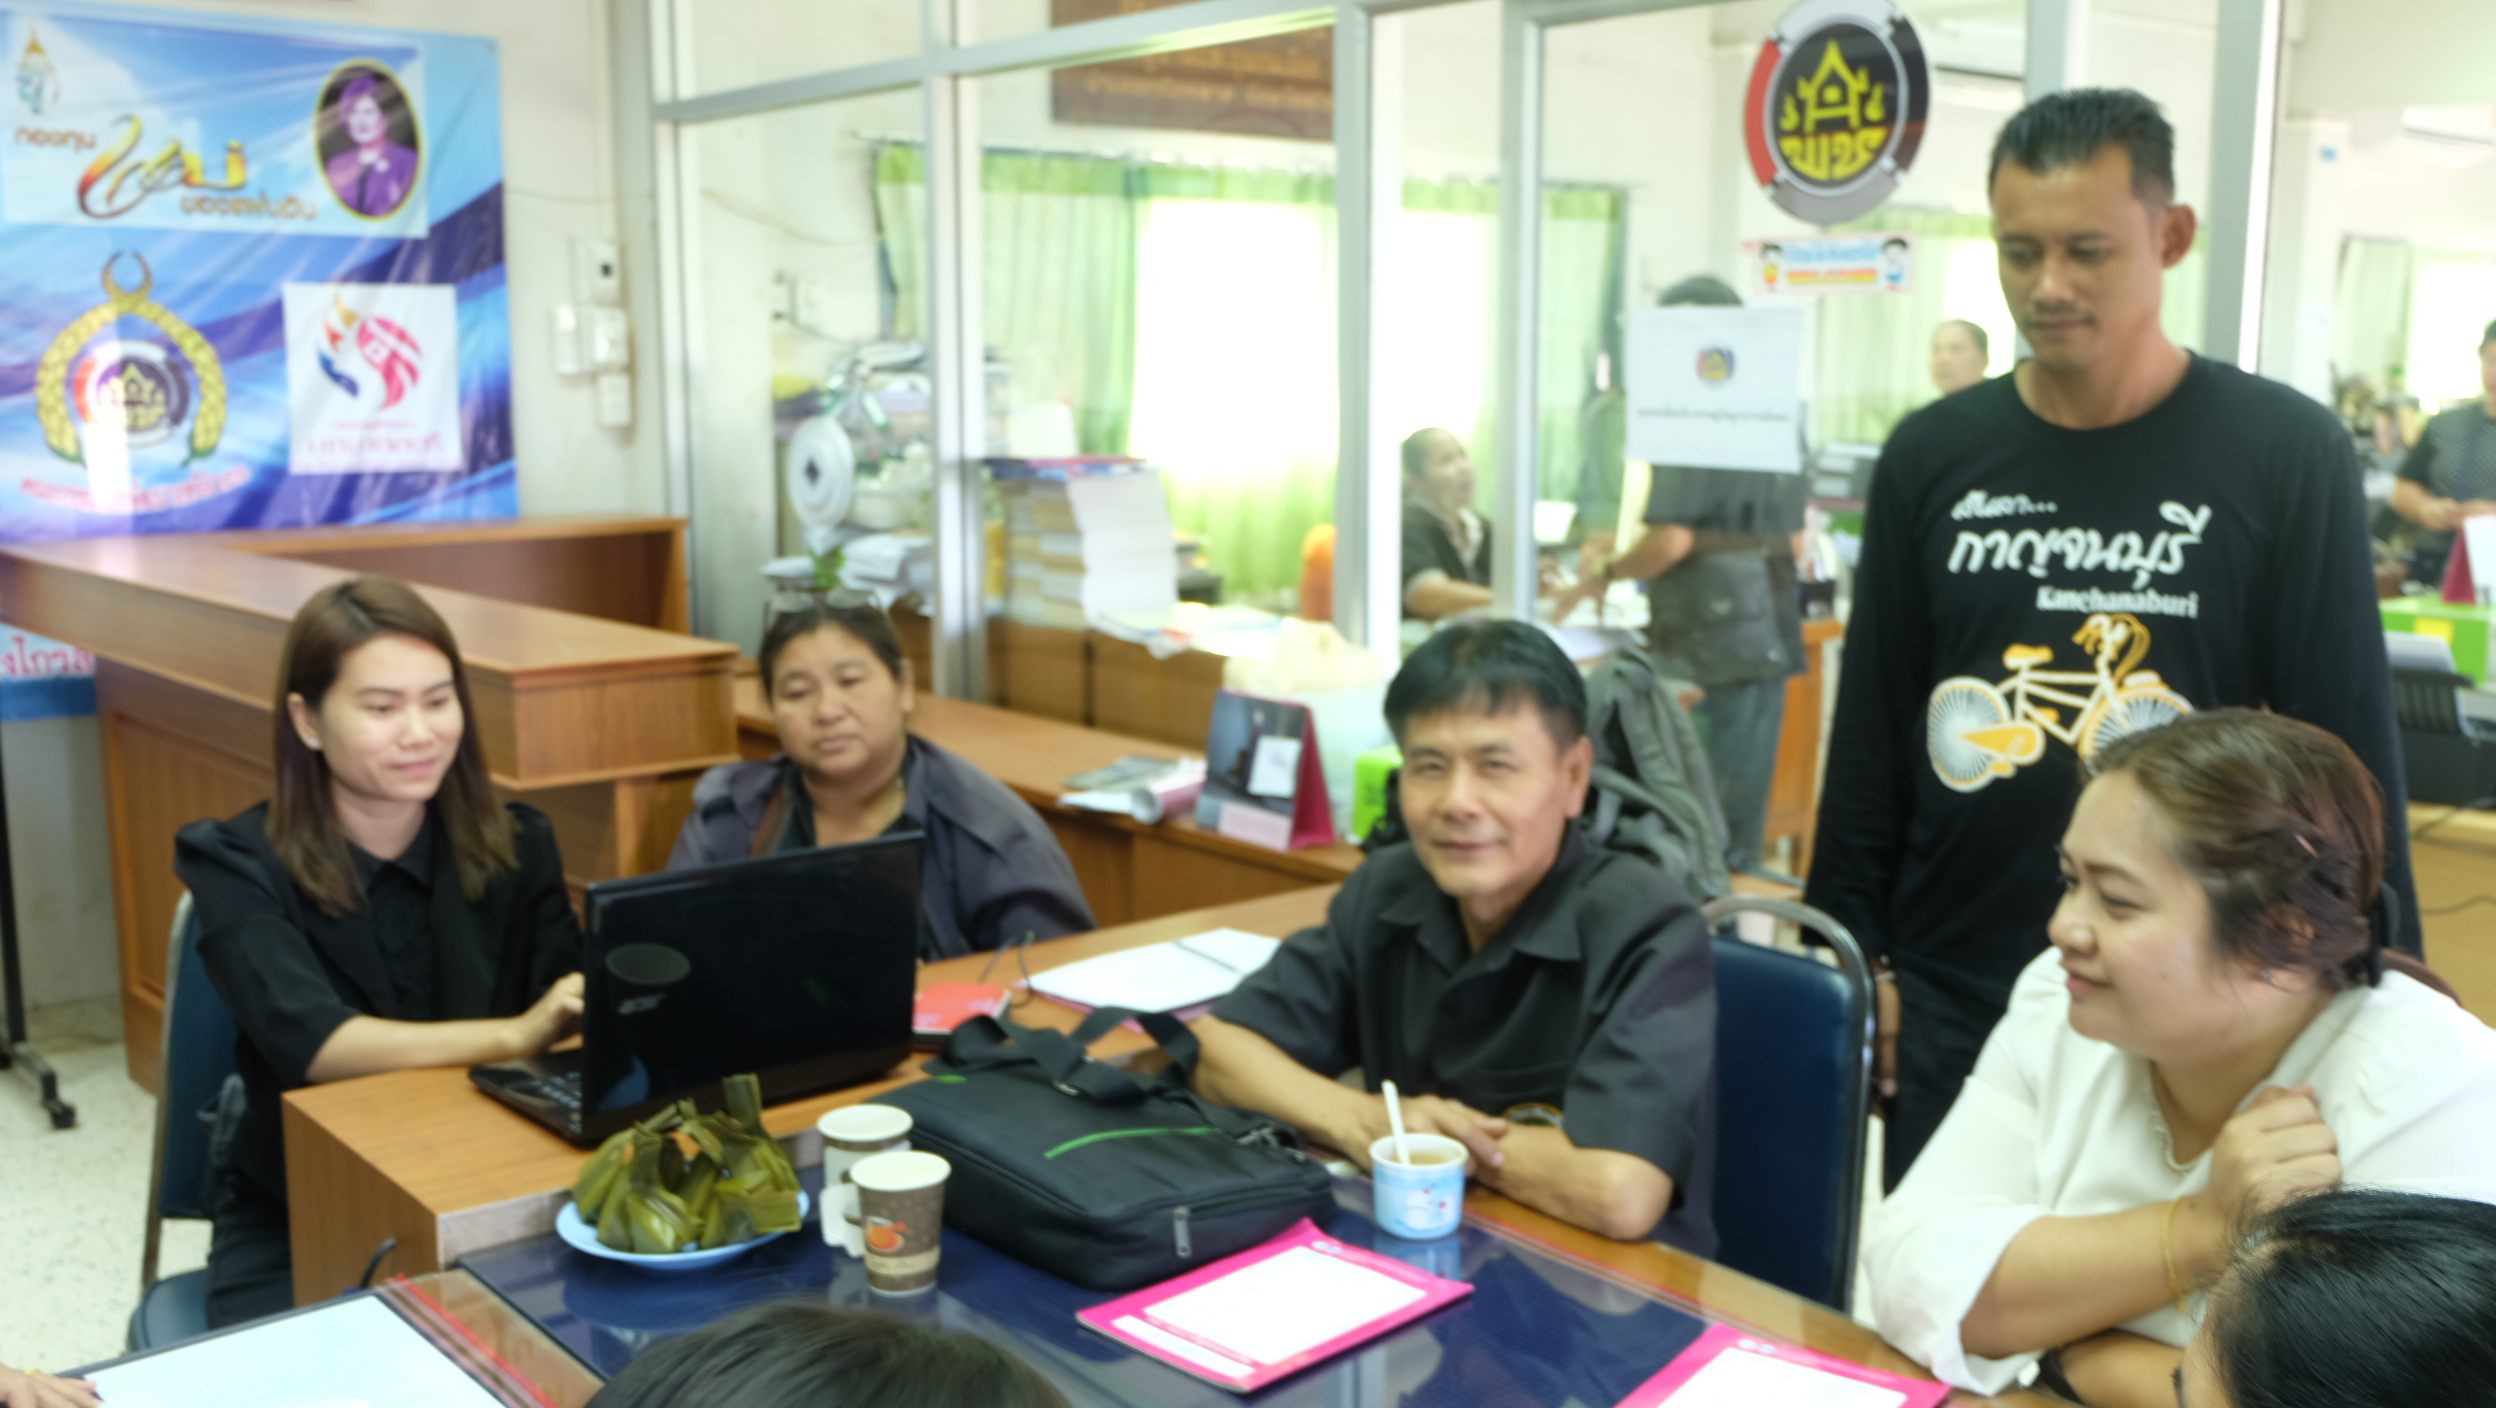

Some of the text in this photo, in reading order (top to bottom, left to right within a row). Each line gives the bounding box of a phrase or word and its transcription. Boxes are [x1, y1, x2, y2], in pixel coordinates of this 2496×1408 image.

[1947, 500, 2213, 590] กาญจนบุรี
[2036, 585, 2200, 619] Kanchanaburi
